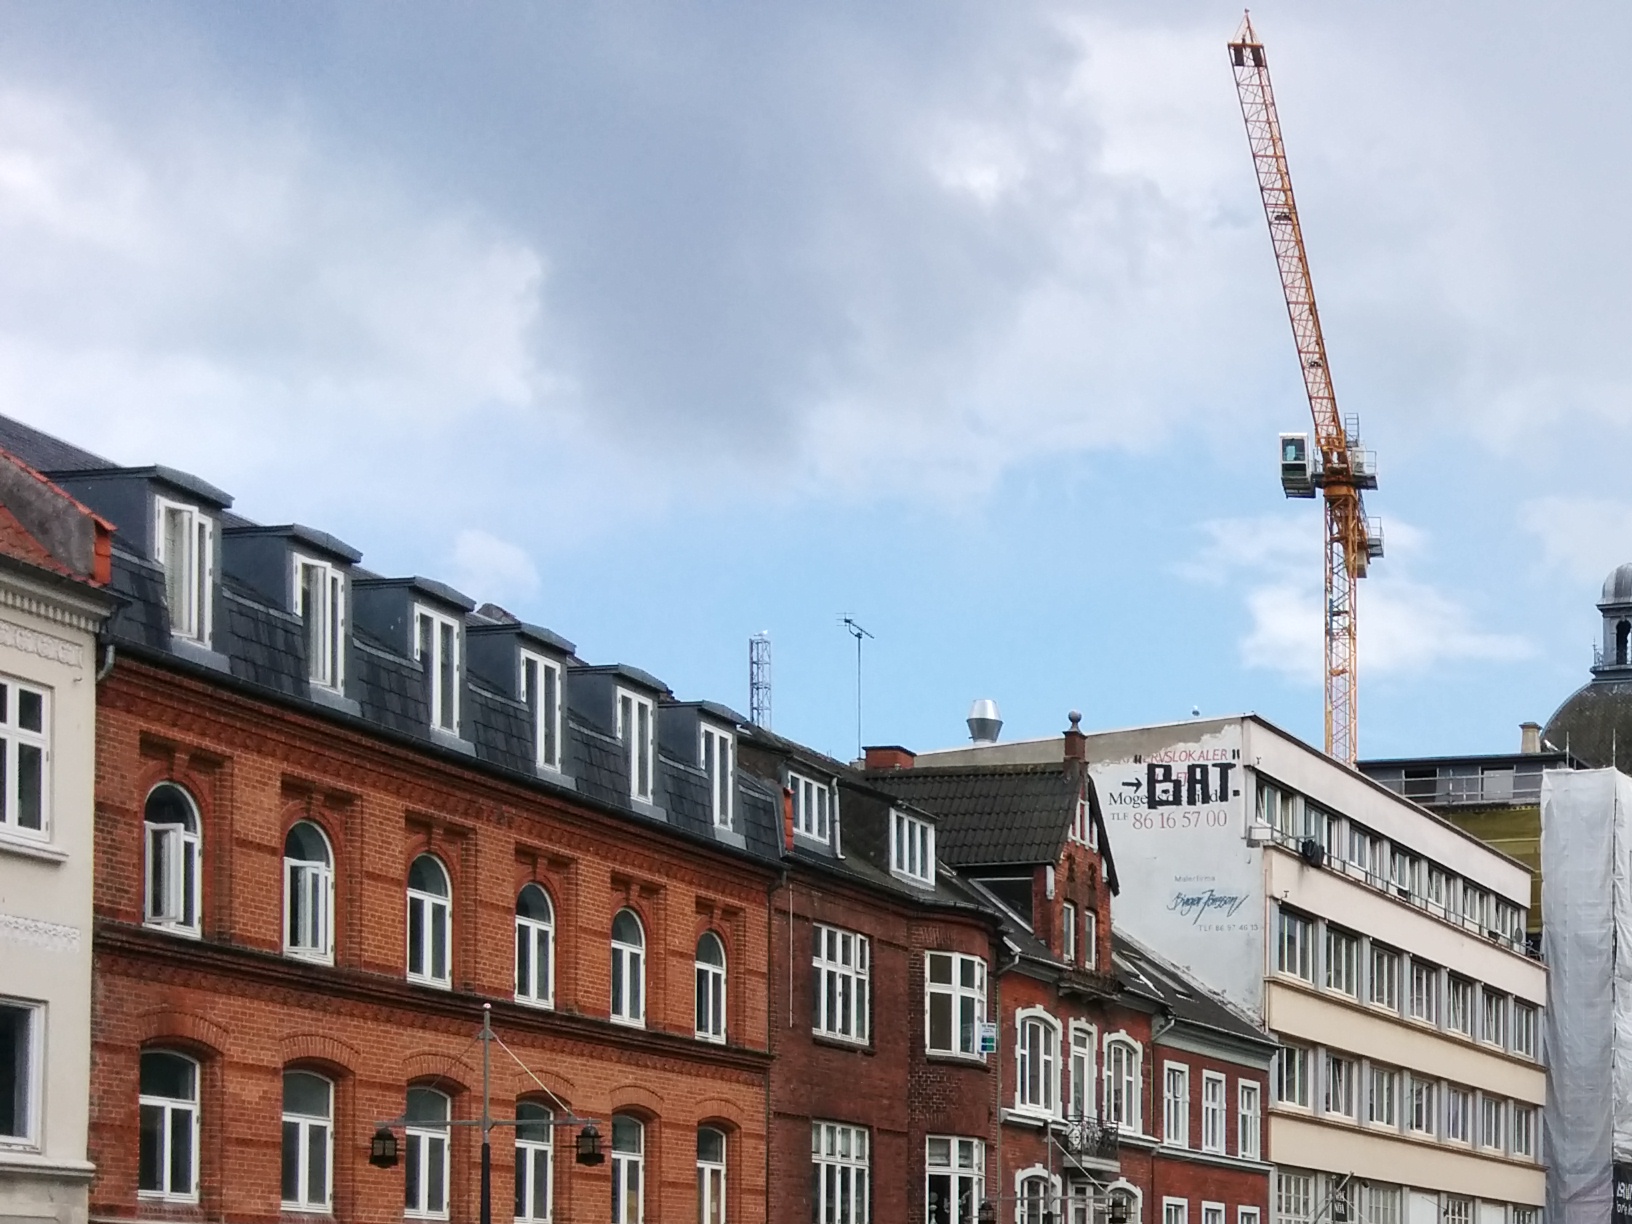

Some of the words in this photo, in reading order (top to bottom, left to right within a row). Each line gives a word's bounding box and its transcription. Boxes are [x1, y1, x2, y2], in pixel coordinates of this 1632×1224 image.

[1132, 812, 1154, 829] 86
[1160, 811, 1176, 829] 16
[1182, 811, 1201, 828] 57
[1206, 810, 1227, 827] 00
